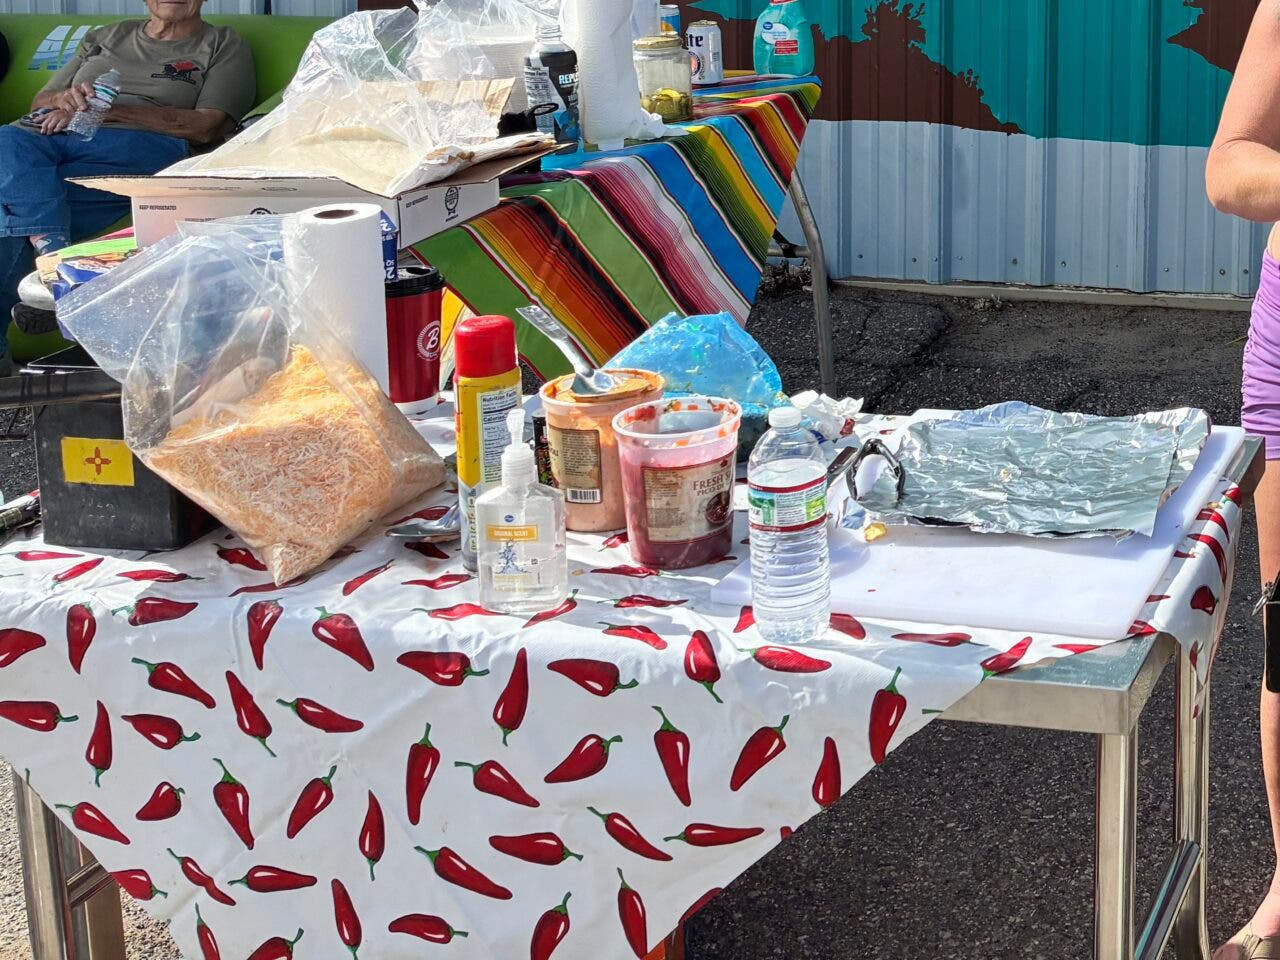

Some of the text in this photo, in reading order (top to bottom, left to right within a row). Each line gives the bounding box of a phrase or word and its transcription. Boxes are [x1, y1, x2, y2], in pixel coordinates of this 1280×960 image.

[558, 72, 579, 85] REPL
[693, 474, 724, 490] FRESH
[697, 487, 716, 496] PICO
